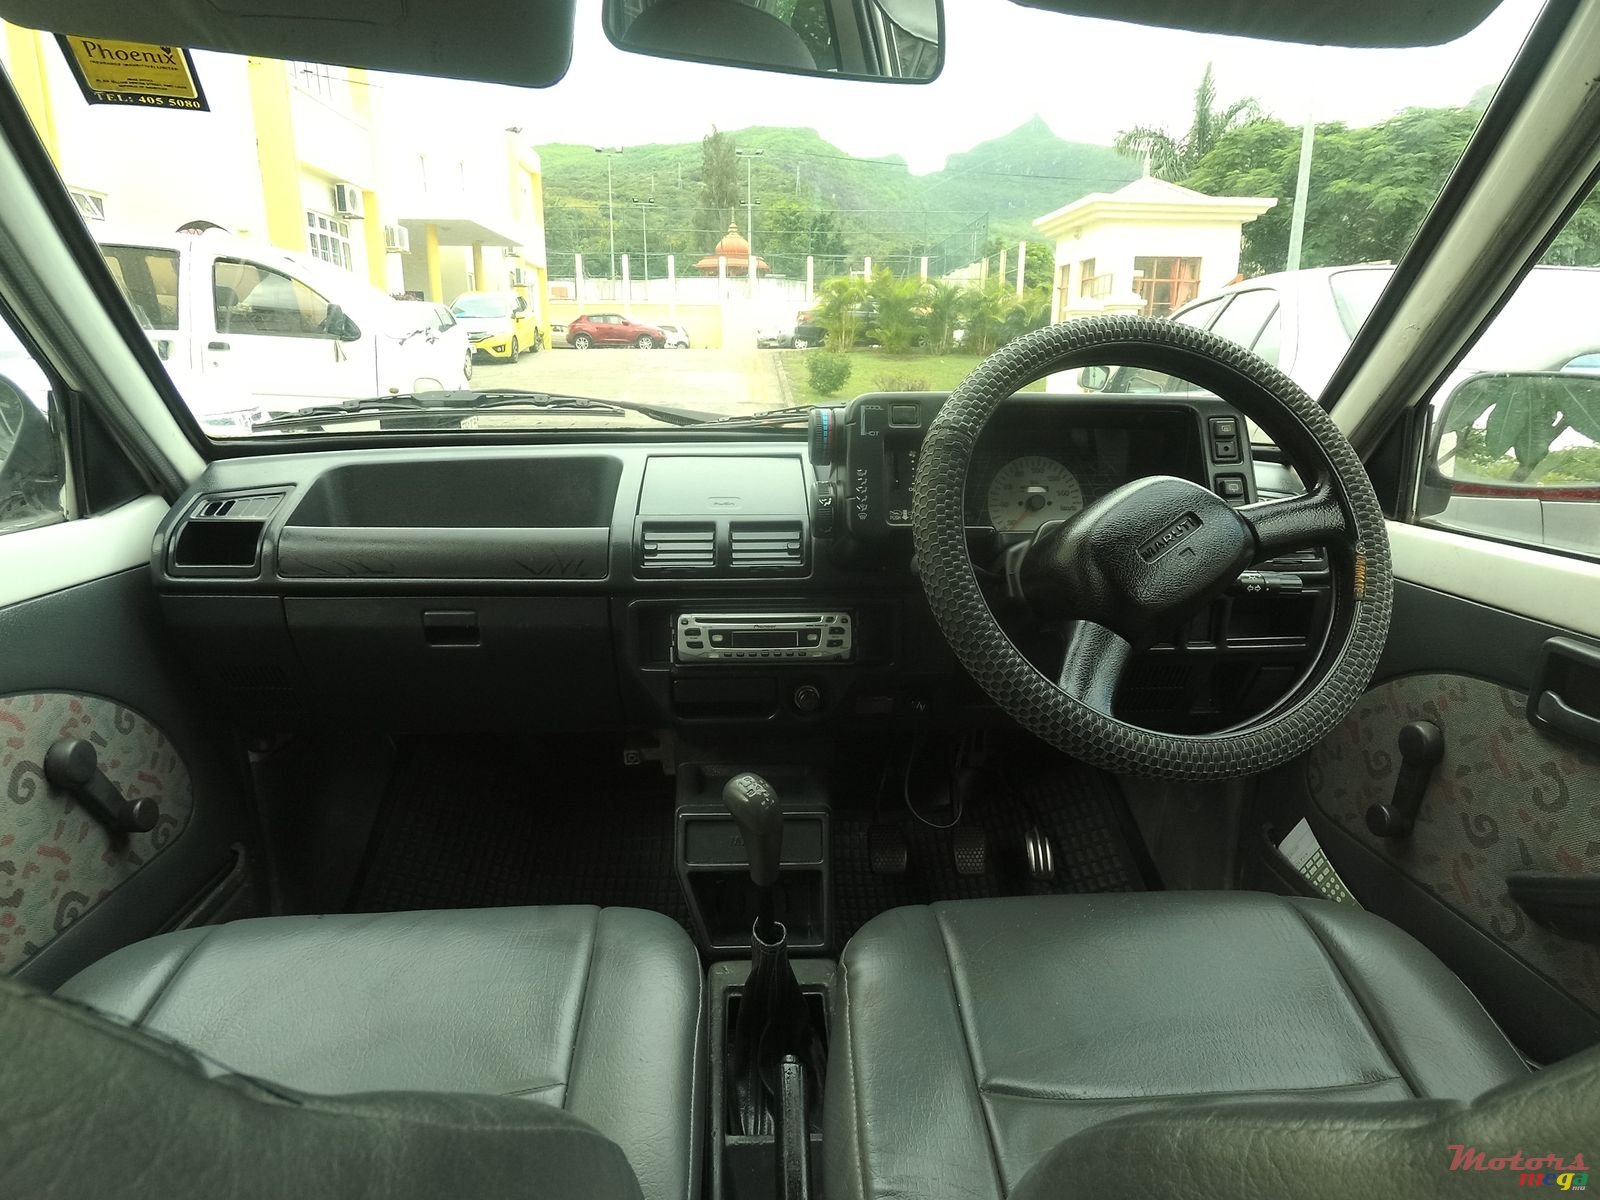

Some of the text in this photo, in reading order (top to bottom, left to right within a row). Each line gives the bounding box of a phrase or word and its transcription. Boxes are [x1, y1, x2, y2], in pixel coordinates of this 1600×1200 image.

[82, 40, 177, 65] Phoenix
[94, 92, 201, 109] TEL: 405 5080
[1141, 517, 1196, 557] MARUTI
